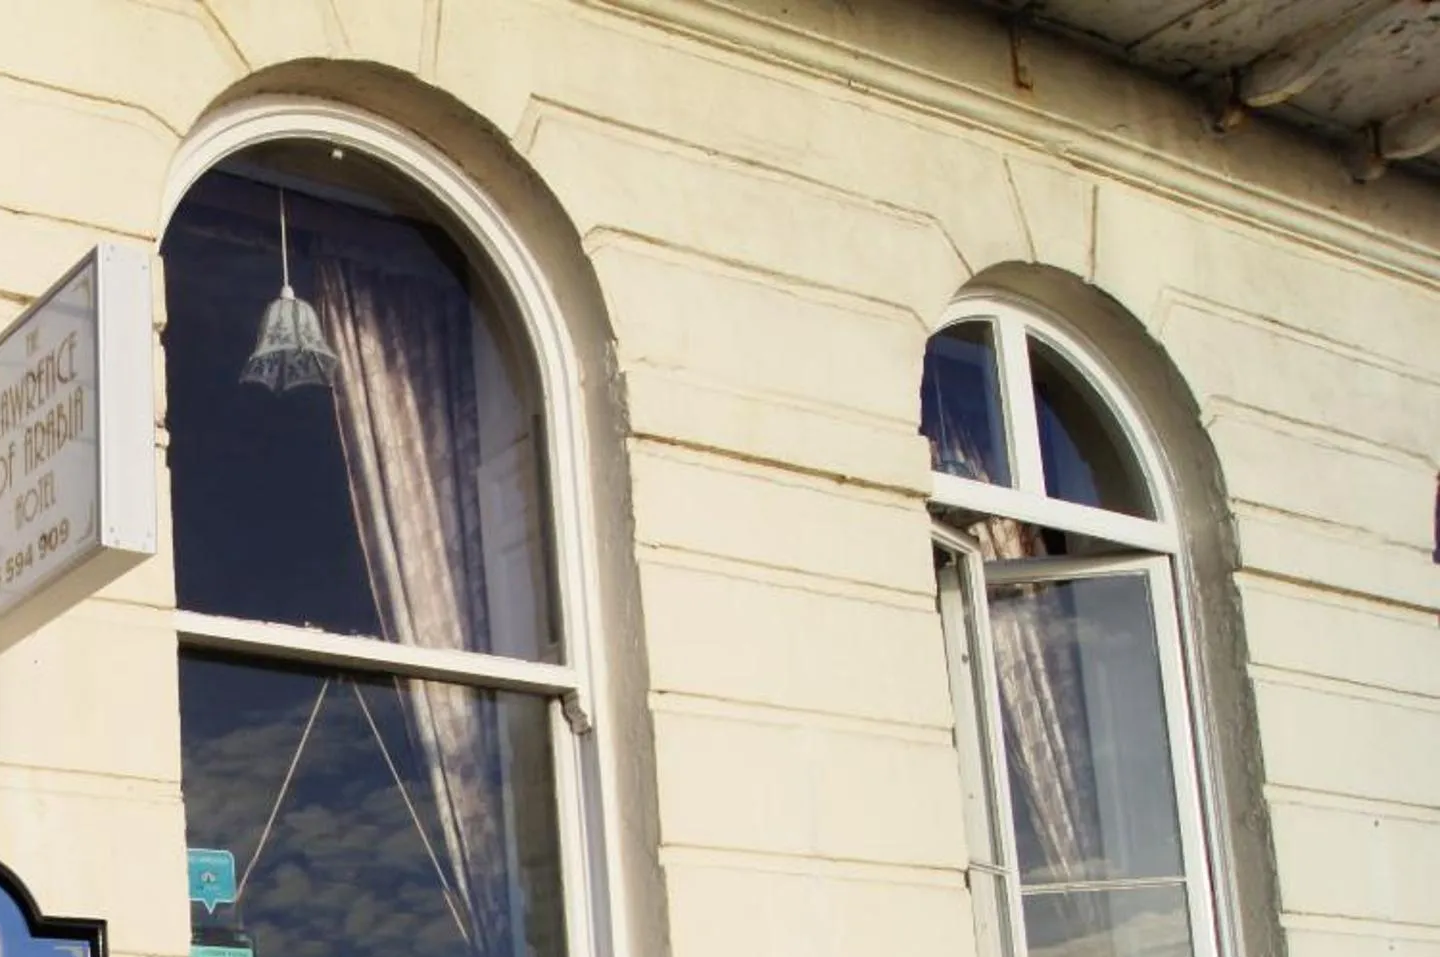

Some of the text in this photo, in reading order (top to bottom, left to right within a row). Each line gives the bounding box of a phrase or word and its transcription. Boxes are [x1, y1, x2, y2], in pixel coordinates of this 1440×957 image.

[24, 385, 85, 477] ARABIA
[14, 470, 57, 531] HOTEL
[5, 548, 34, 583] 594
[37, 517, 71, 560] 909
